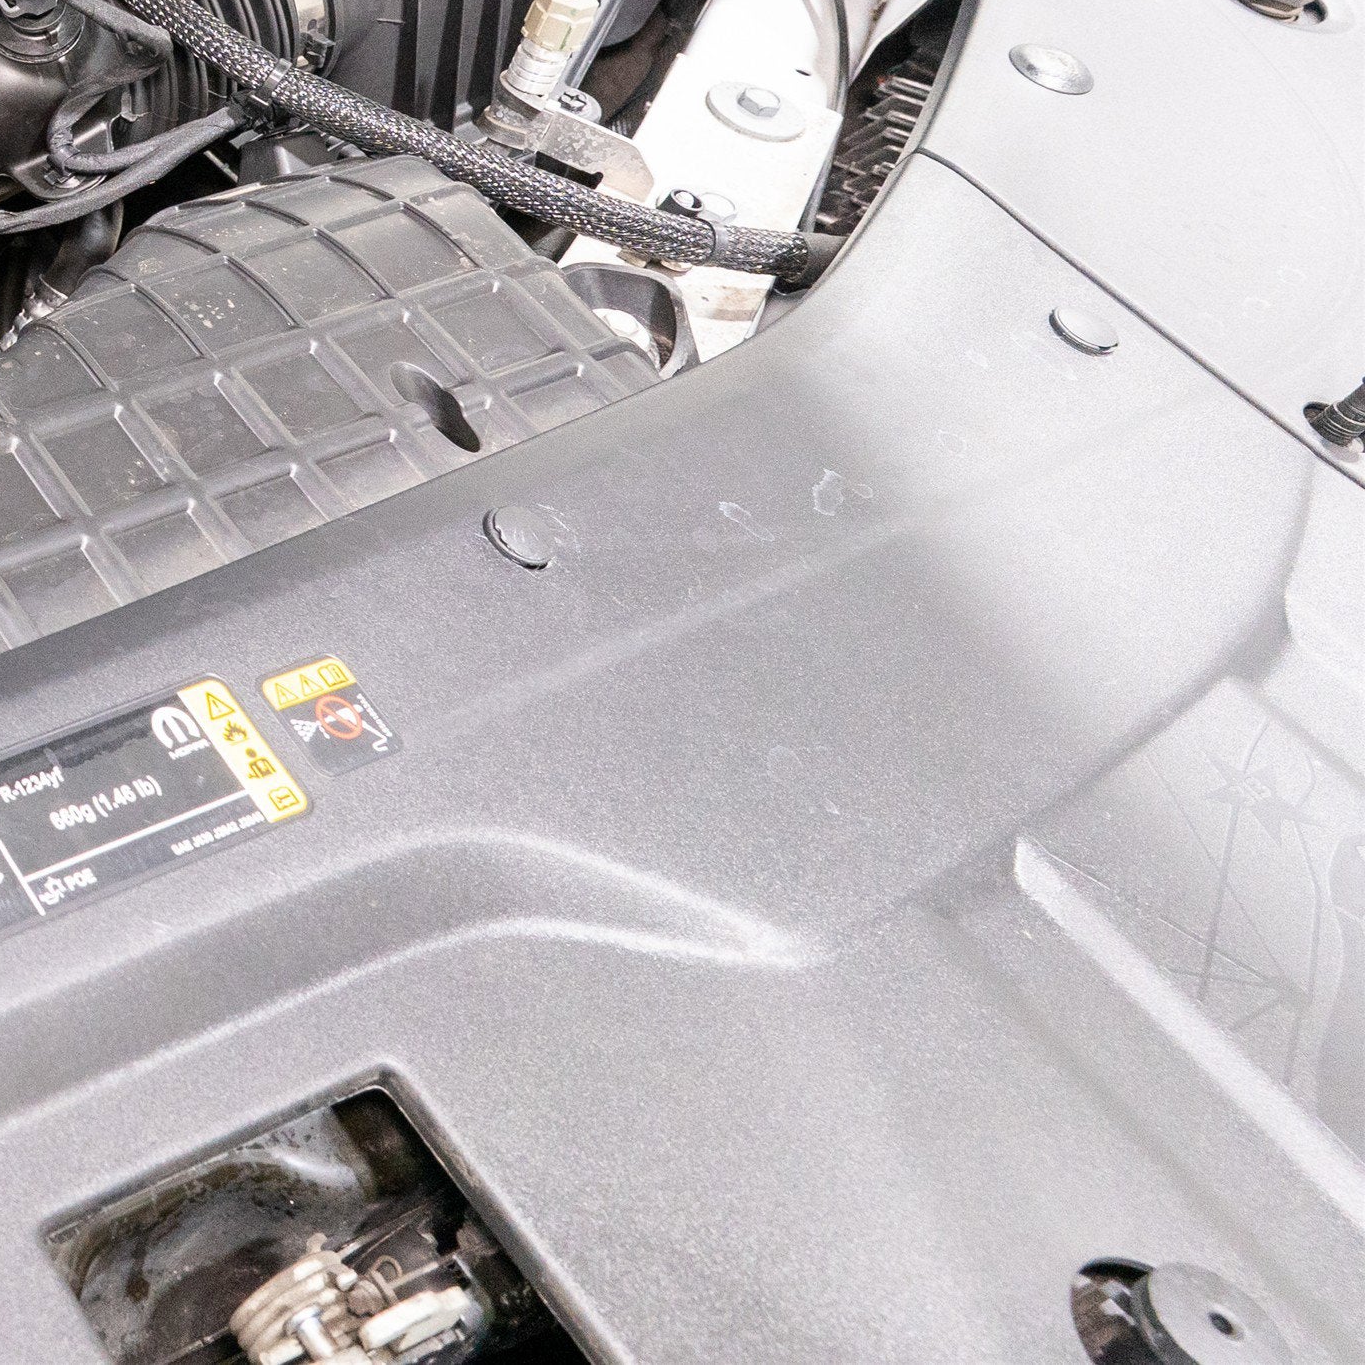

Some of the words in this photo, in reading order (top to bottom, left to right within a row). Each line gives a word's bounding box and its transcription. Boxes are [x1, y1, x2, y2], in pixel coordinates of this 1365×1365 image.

[49, 804, 97, 831] 660g
[92, 784, 137, 818] (1.46
[132, 775, 163, 803] lb)
[62, 867, 98, 892] POE
